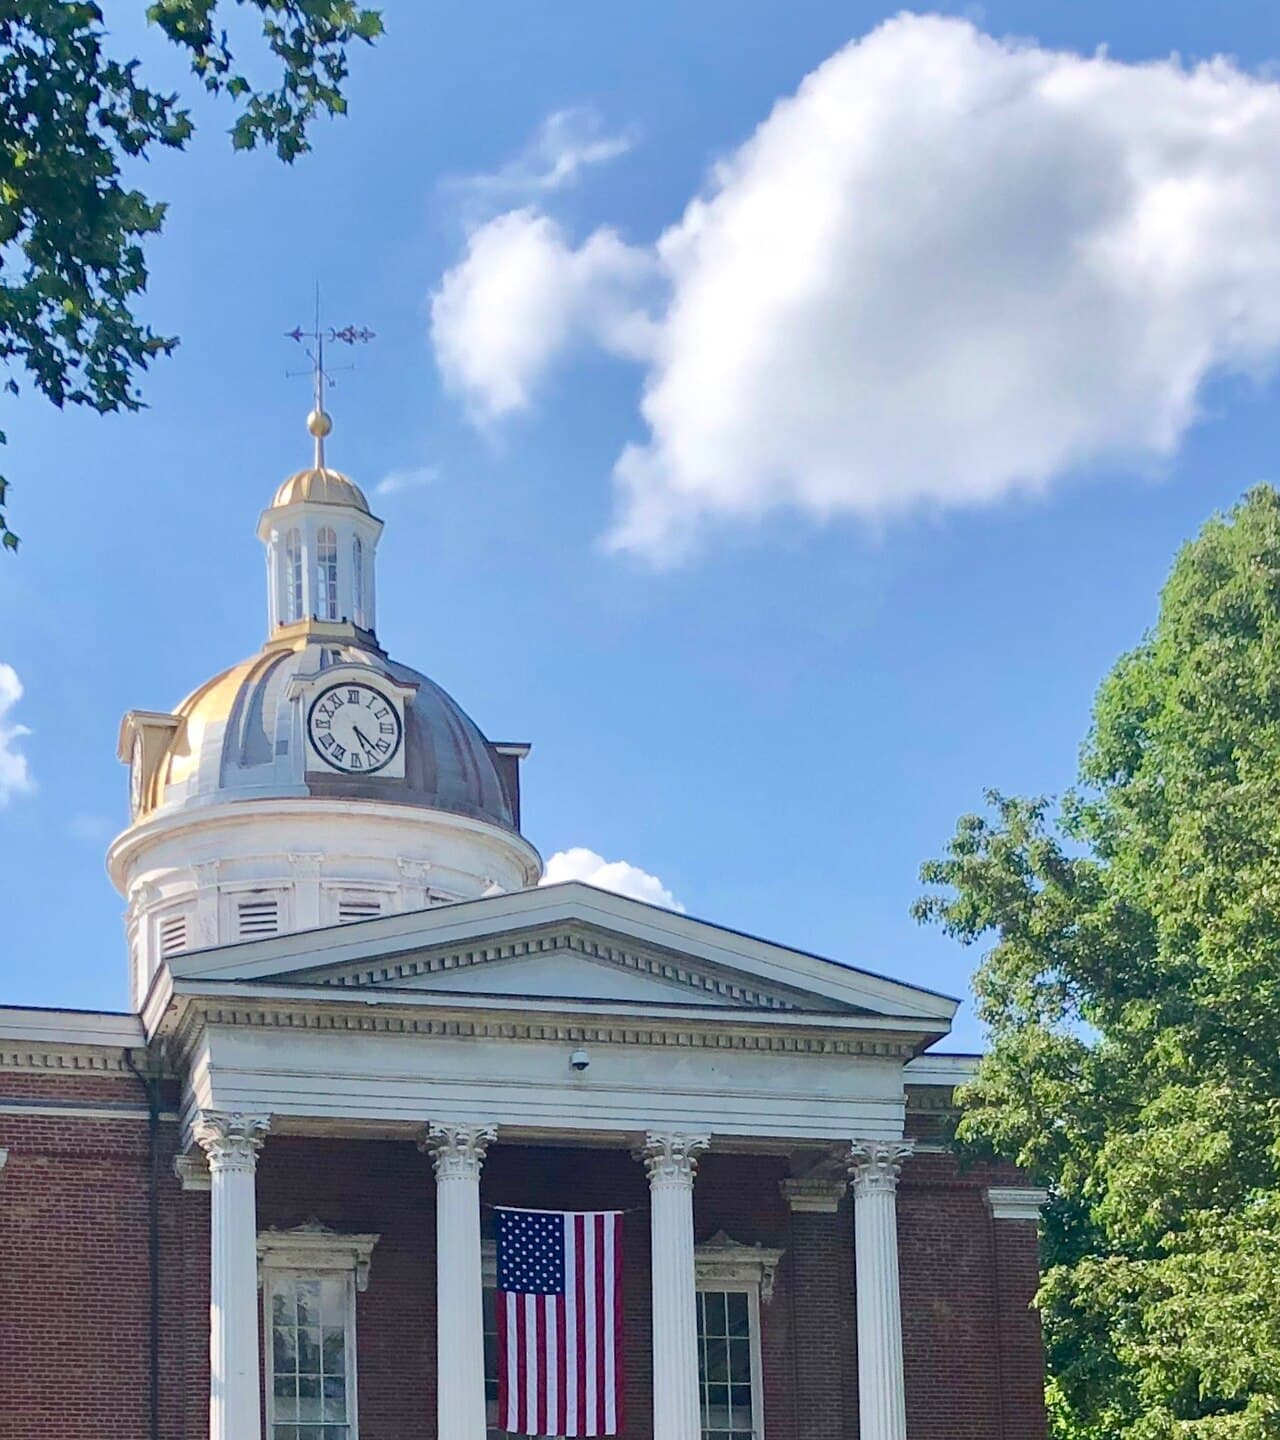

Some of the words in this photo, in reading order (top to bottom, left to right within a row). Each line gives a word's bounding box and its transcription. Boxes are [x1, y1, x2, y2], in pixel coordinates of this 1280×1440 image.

[327, 693, 344, 710] XI
[347, 690, 360, 704] XII
[365, 696, 378, 710] I
[319, 704, 334, 718] X
[374, 707, 390, 720] II
[316, 719, 331, 730] IX
[379, 722, 394, 735] III
[365, 750, 380, 767] V
